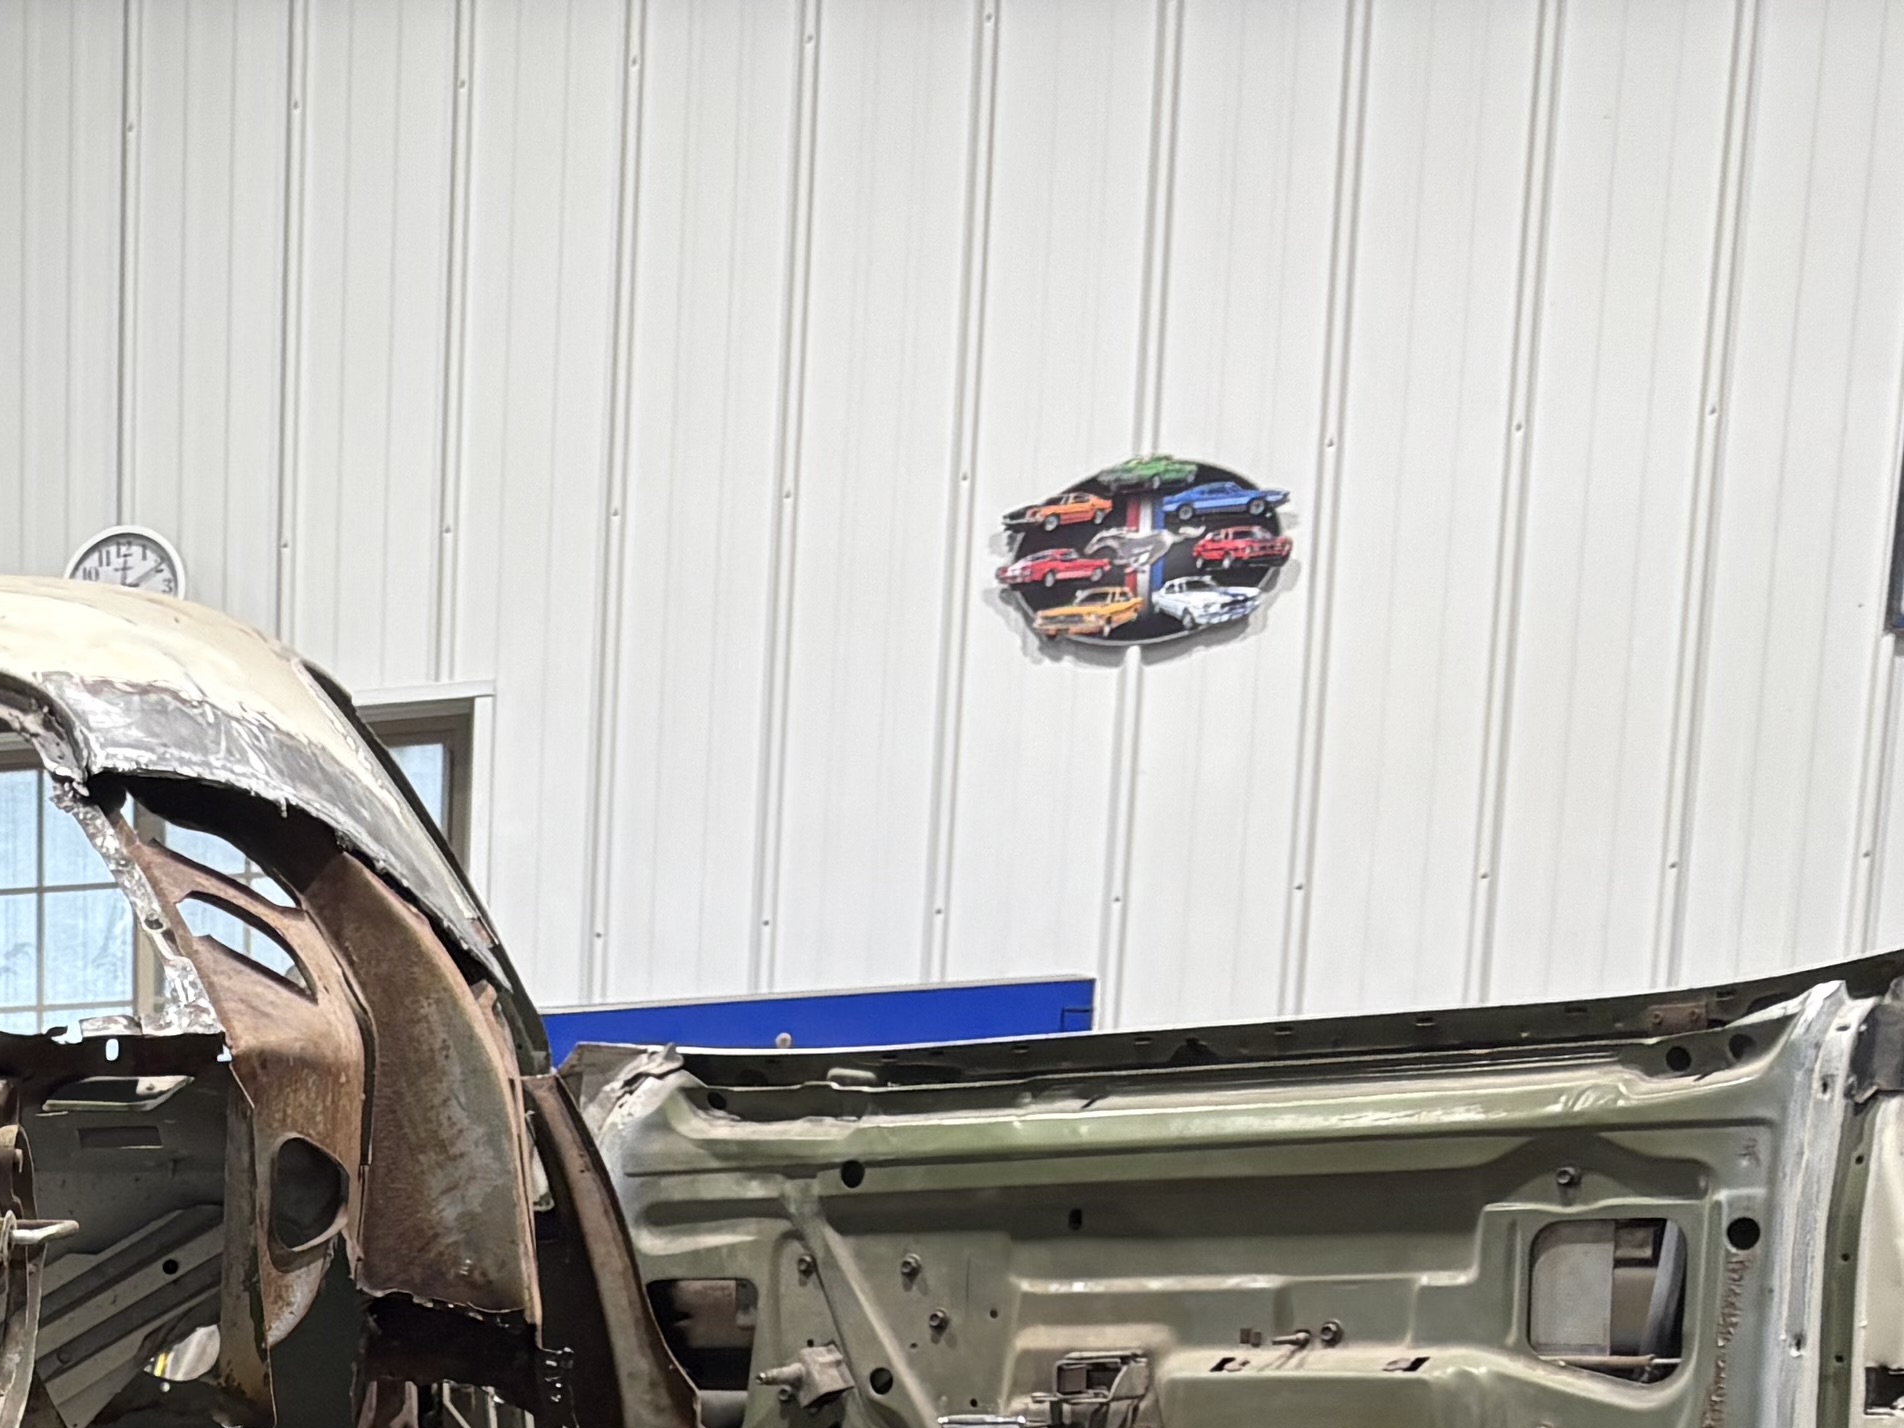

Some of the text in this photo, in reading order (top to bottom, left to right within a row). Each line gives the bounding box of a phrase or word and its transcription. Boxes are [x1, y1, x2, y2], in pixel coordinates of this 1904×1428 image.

[98, 548, 111, 567] 11
[115, 540, 133, 559] 12
[82, 566, 100, 582] 10
